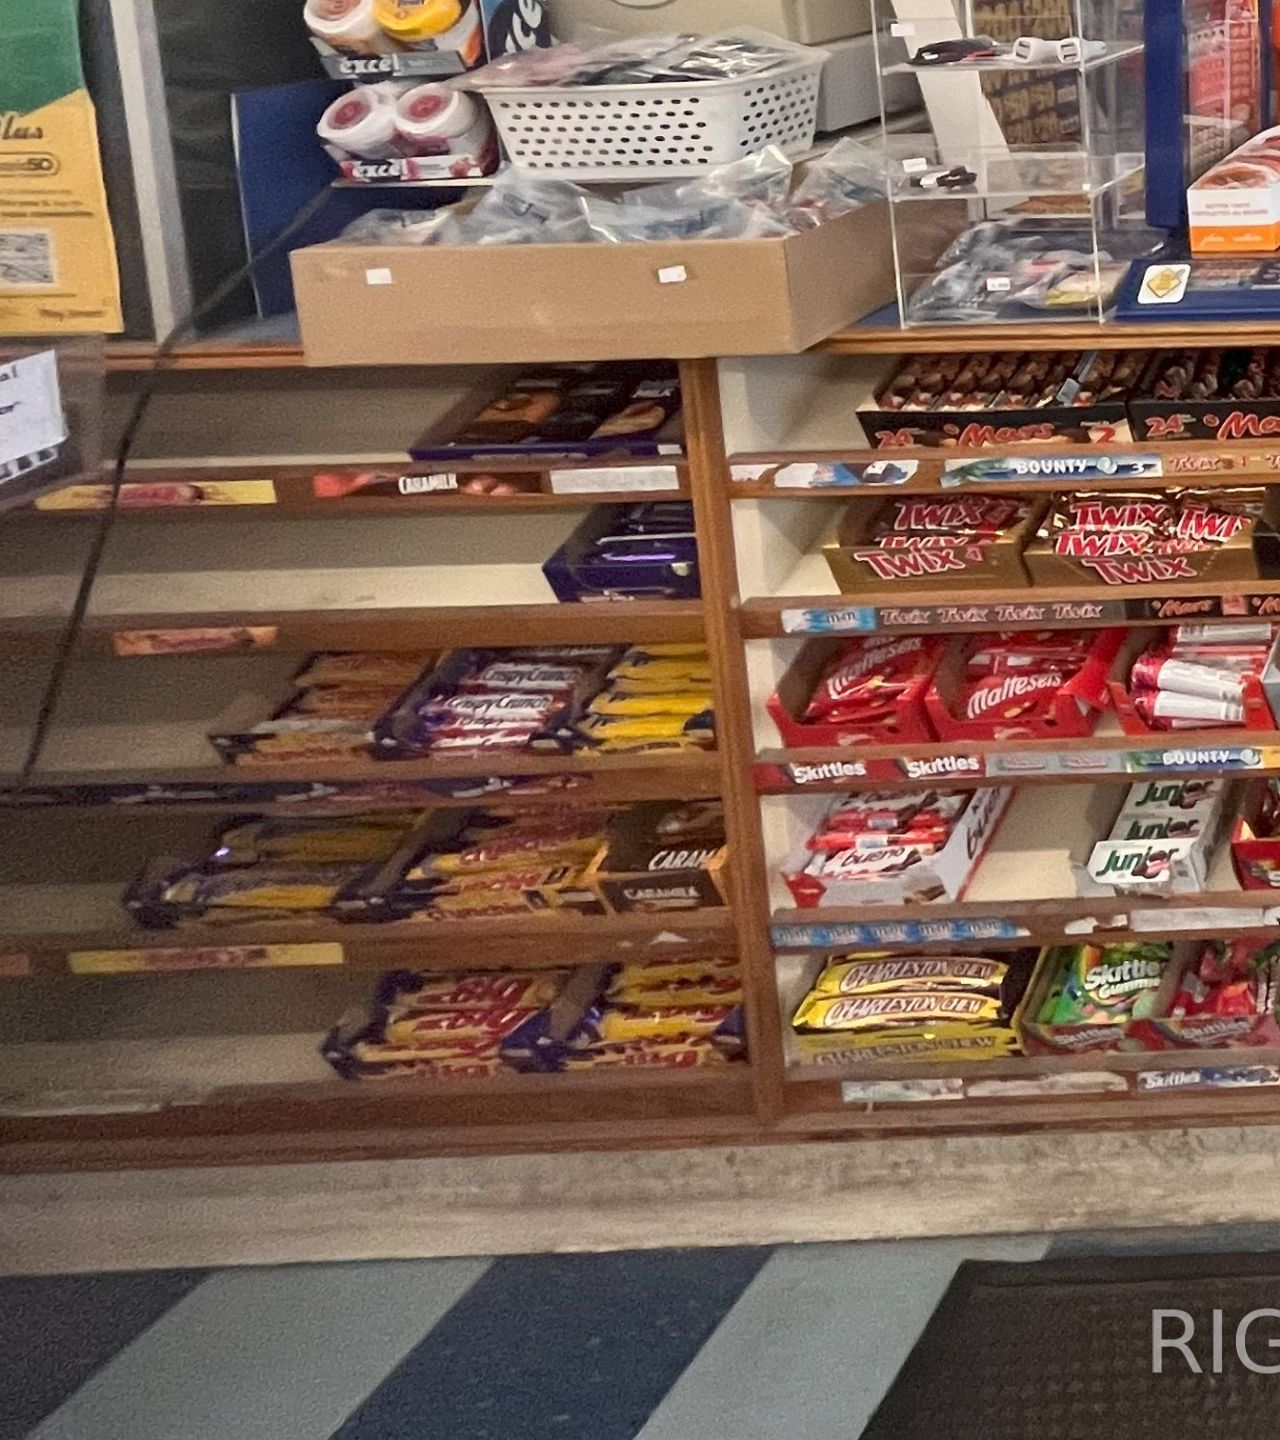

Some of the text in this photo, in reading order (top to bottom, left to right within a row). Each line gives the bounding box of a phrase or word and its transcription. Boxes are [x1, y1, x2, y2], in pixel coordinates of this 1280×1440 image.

[339, 53, 401, 76] excel
[958, 422, 1055, 448] Mars
[1016, 458, 1145, 474] BOUNTY 3
[855, 549, 967, 581] TWIX
[1084, 556, 1198, 585] TWIX
[966, 671, 1063, 720] Maltesers
[907, 755, 980, 778] Skittles
[1162, 750, 1230, 766] BOUNTY
[793, 760, 867, 784] Skittles
[840, 845, 906, 867] bueno
[823, 995, 984, 1026] CHARLESTON CHEW
